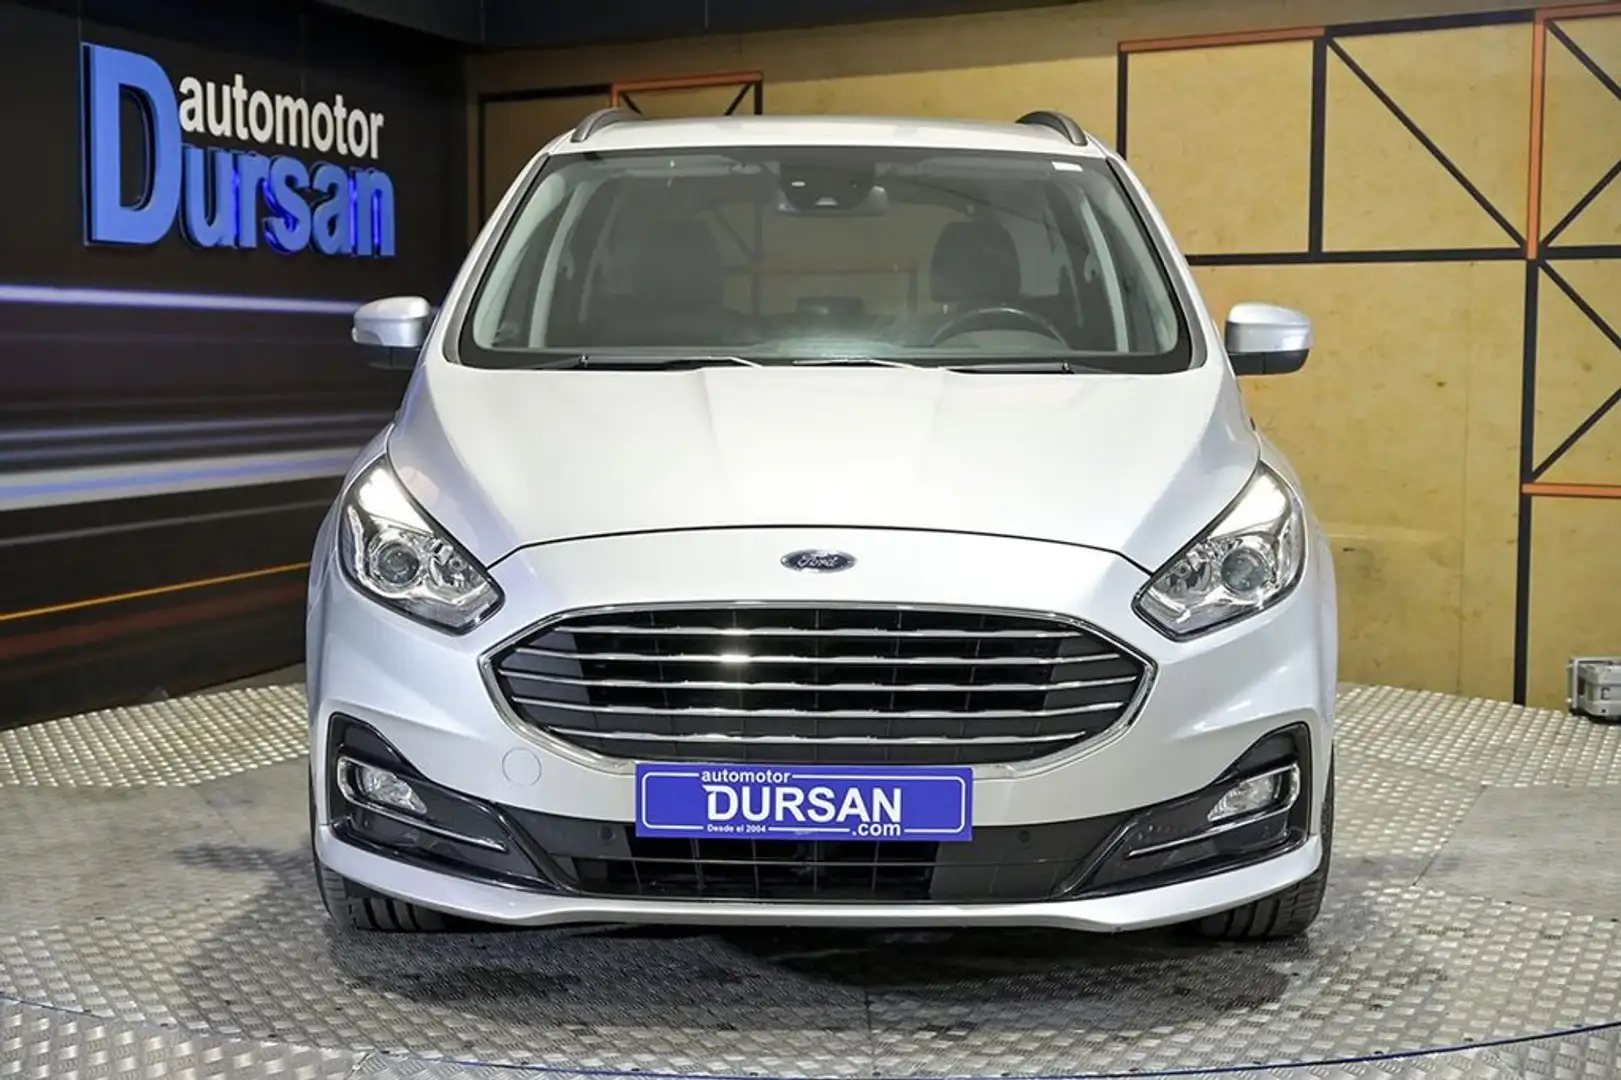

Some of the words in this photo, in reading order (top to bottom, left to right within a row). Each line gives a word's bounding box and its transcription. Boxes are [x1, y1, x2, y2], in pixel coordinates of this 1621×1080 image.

[178, 74, 384, 159] automotor
[80, 42, 396, 257] Dursan
[797, 552, 839, 568] Ford
[701, 769, 792, 783] automotor
[702, 785, 901, 822] DURSAN
[707, 823, 734, 833] Desde
[736, 824, 744, 833] el
[746, 824, 766, 833] 2004
[852, 821, 901, 837] .com
